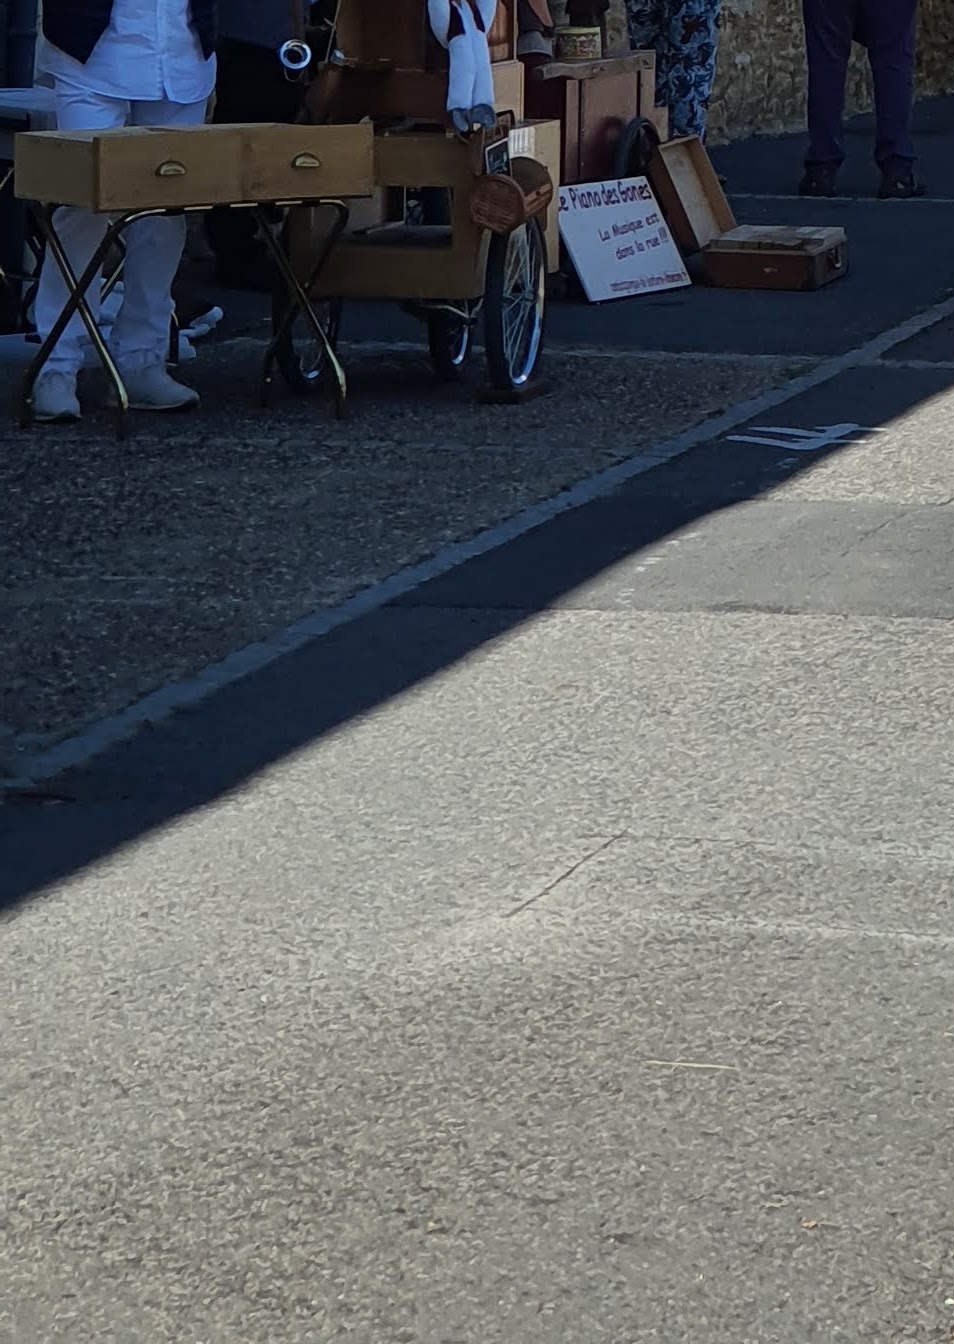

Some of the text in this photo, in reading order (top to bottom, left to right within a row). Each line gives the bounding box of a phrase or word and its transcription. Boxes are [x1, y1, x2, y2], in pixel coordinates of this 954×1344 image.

[568, 187, 602, 209] Piano
[601, 184, 620, 206] des
[617, 181, 652, 203] Gones
[612, 219, 644, 236] Musique
[615, 245, 635, 260] dans
